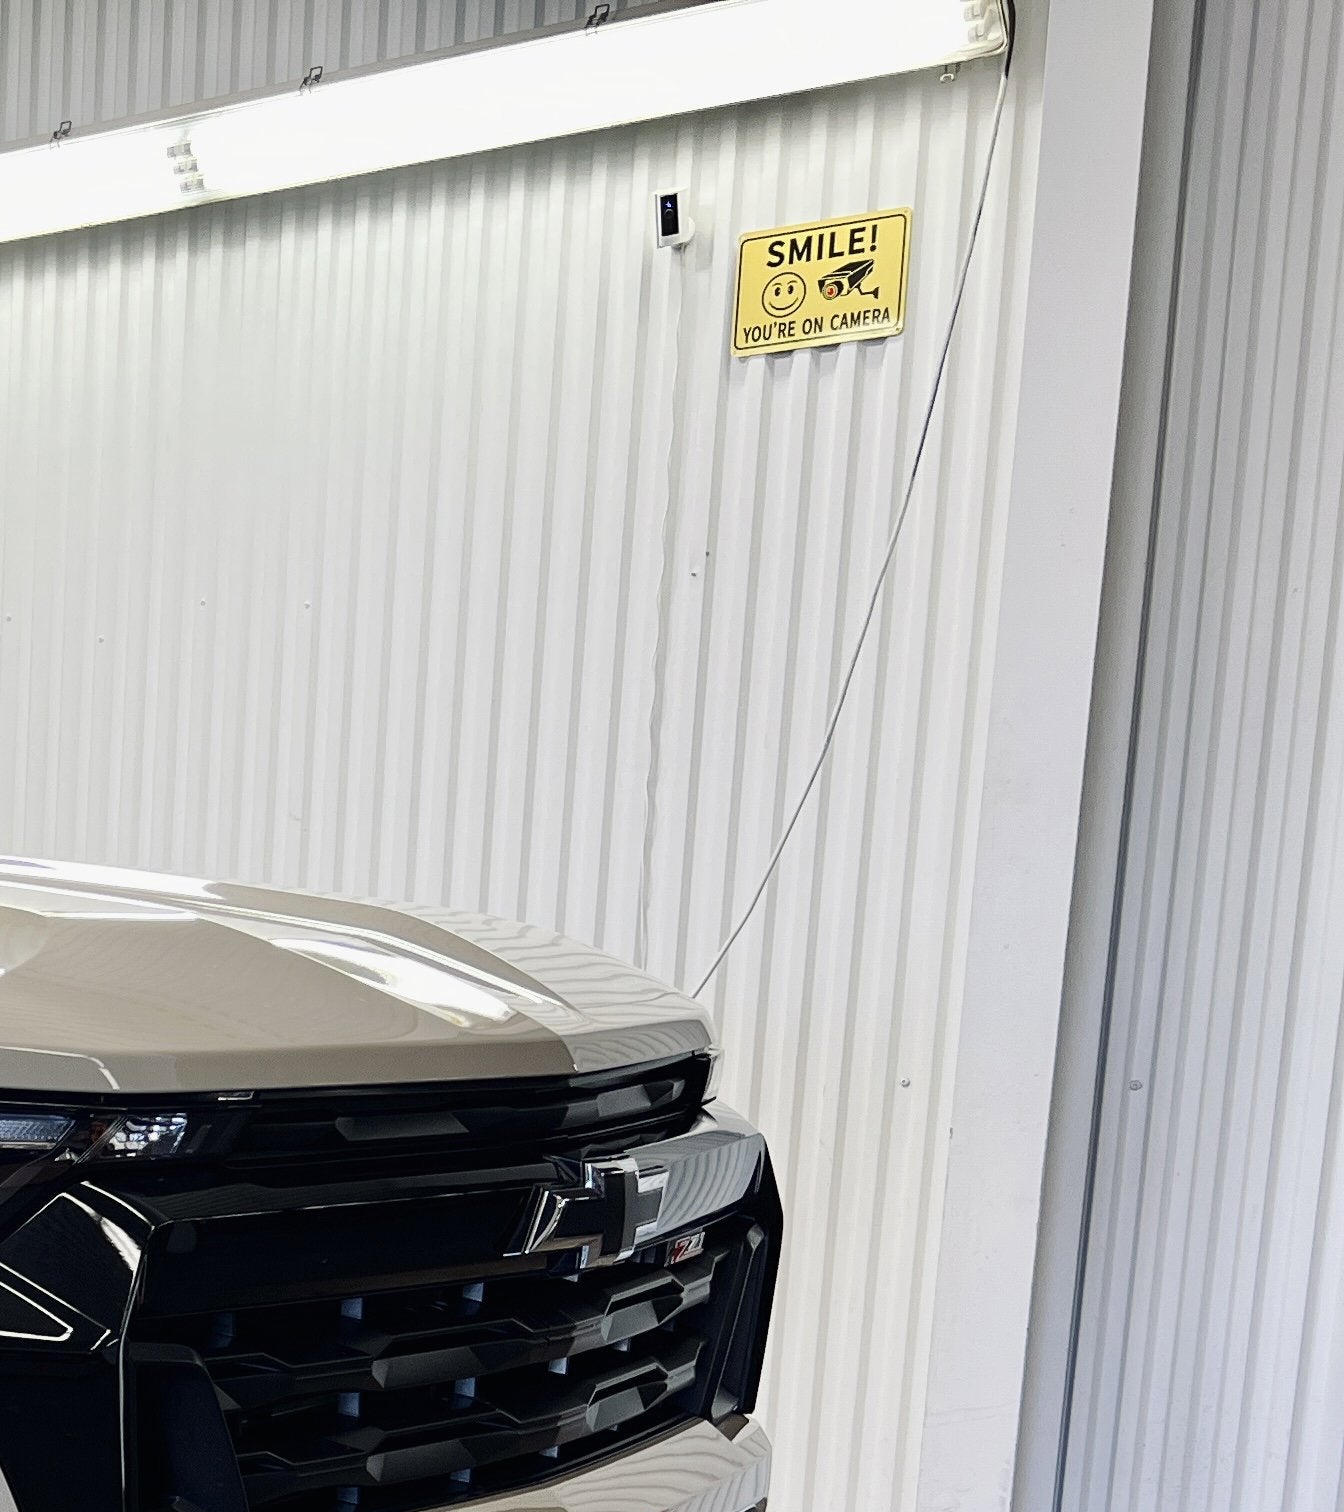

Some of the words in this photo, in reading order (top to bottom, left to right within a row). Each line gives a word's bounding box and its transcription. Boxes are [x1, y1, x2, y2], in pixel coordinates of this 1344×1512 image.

[766, 224, 879, 267] SMILE!
[743, 320, 796, 343] YOU'RE
[802, 316, 823, 335] ON
[830, 307, 891, 330] CAMERA
